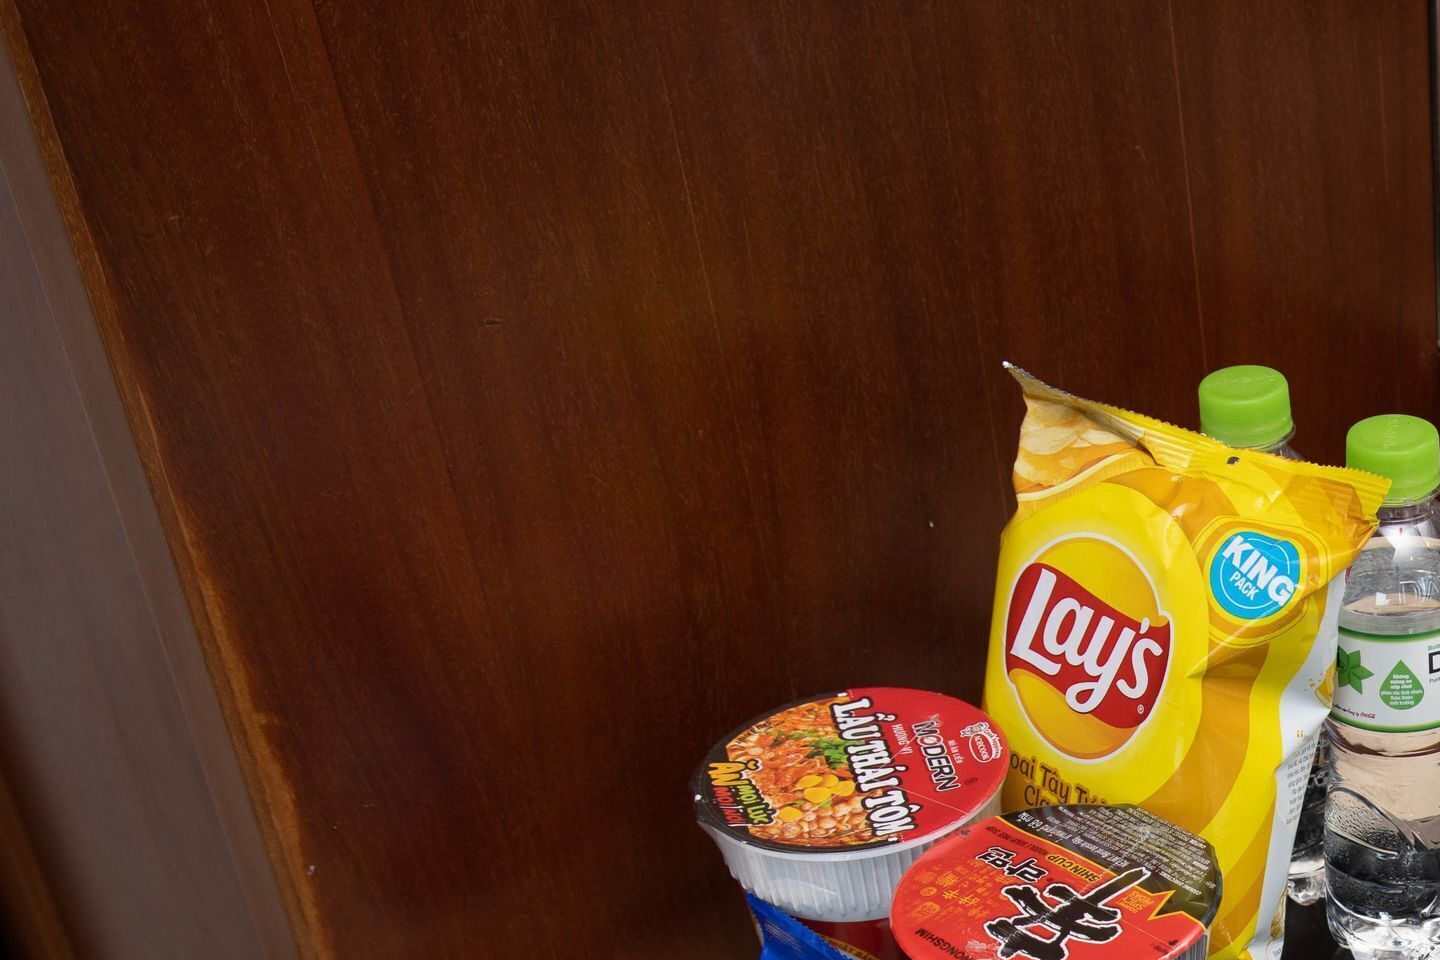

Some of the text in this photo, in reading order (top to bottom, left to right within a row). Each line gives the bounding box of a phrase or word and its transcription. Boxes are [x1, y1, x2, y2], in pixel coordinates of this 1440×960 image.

[1222, 535, 1294, 607] KING
[1229, 571, 1259, 601] PACK
[1010, 568, 1163, 713] Lay's
[832, 698, 921, 836] LẨU THÁI TÔM
[912, 720, 961, 791] MODERN
[1041, 764, 1070, 804] Tây
[977, 847, 1048, 882] 라면
